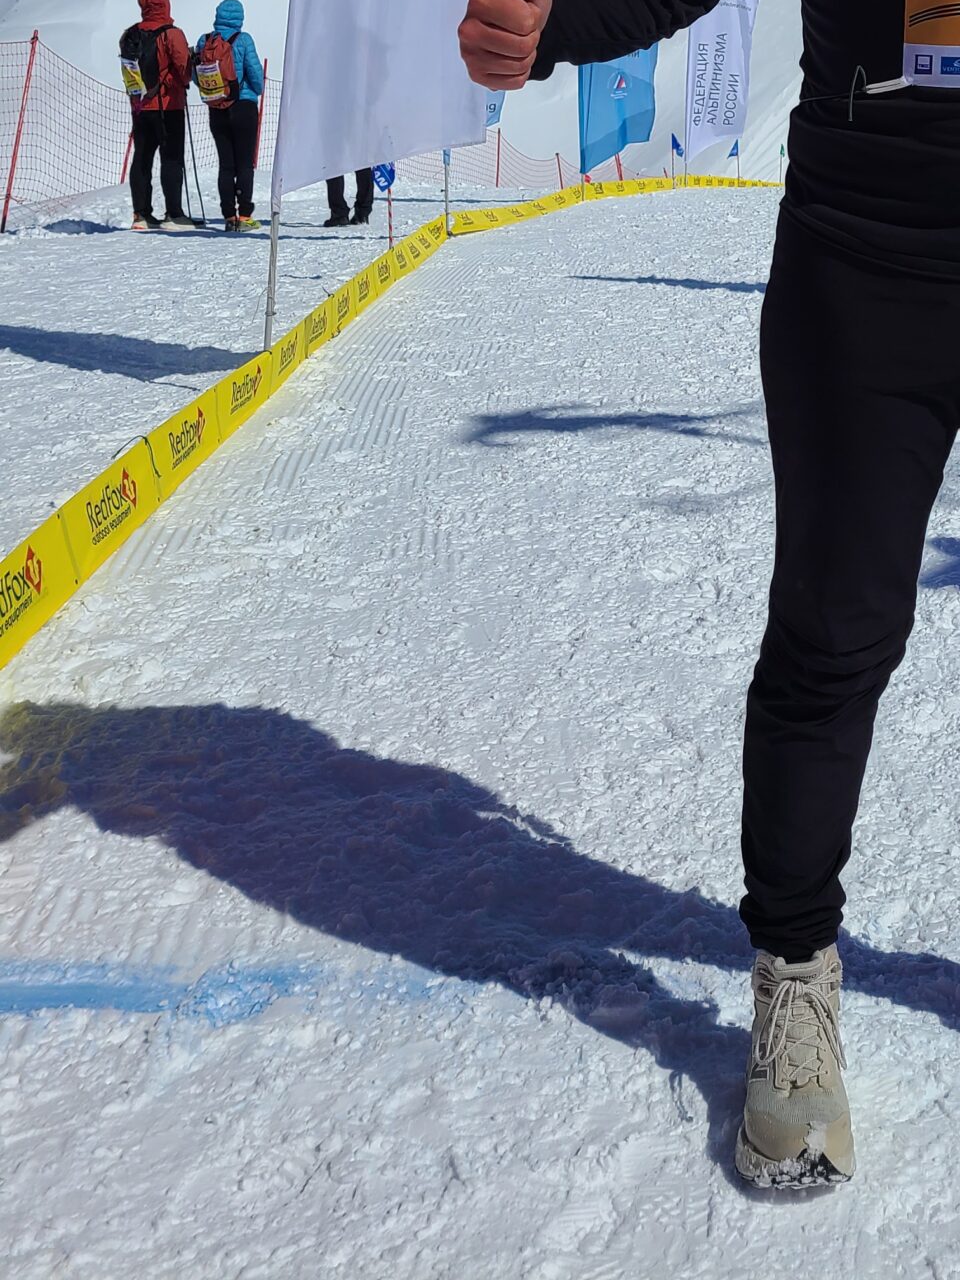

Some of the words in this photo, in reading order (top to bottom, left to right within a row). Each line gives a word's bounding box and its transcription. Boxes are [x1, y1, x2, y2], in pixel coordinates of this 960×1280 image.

[693, 43, 710, 127] ФЕДЕРАЦИЯ
[706, 32, 729, 125] АЛЬПИНИЗМА
[722, 73, 741, 126] РОССИИ
[169, 419, 198, 459] RedFox
[86, 484, 128, 533] RedFox
